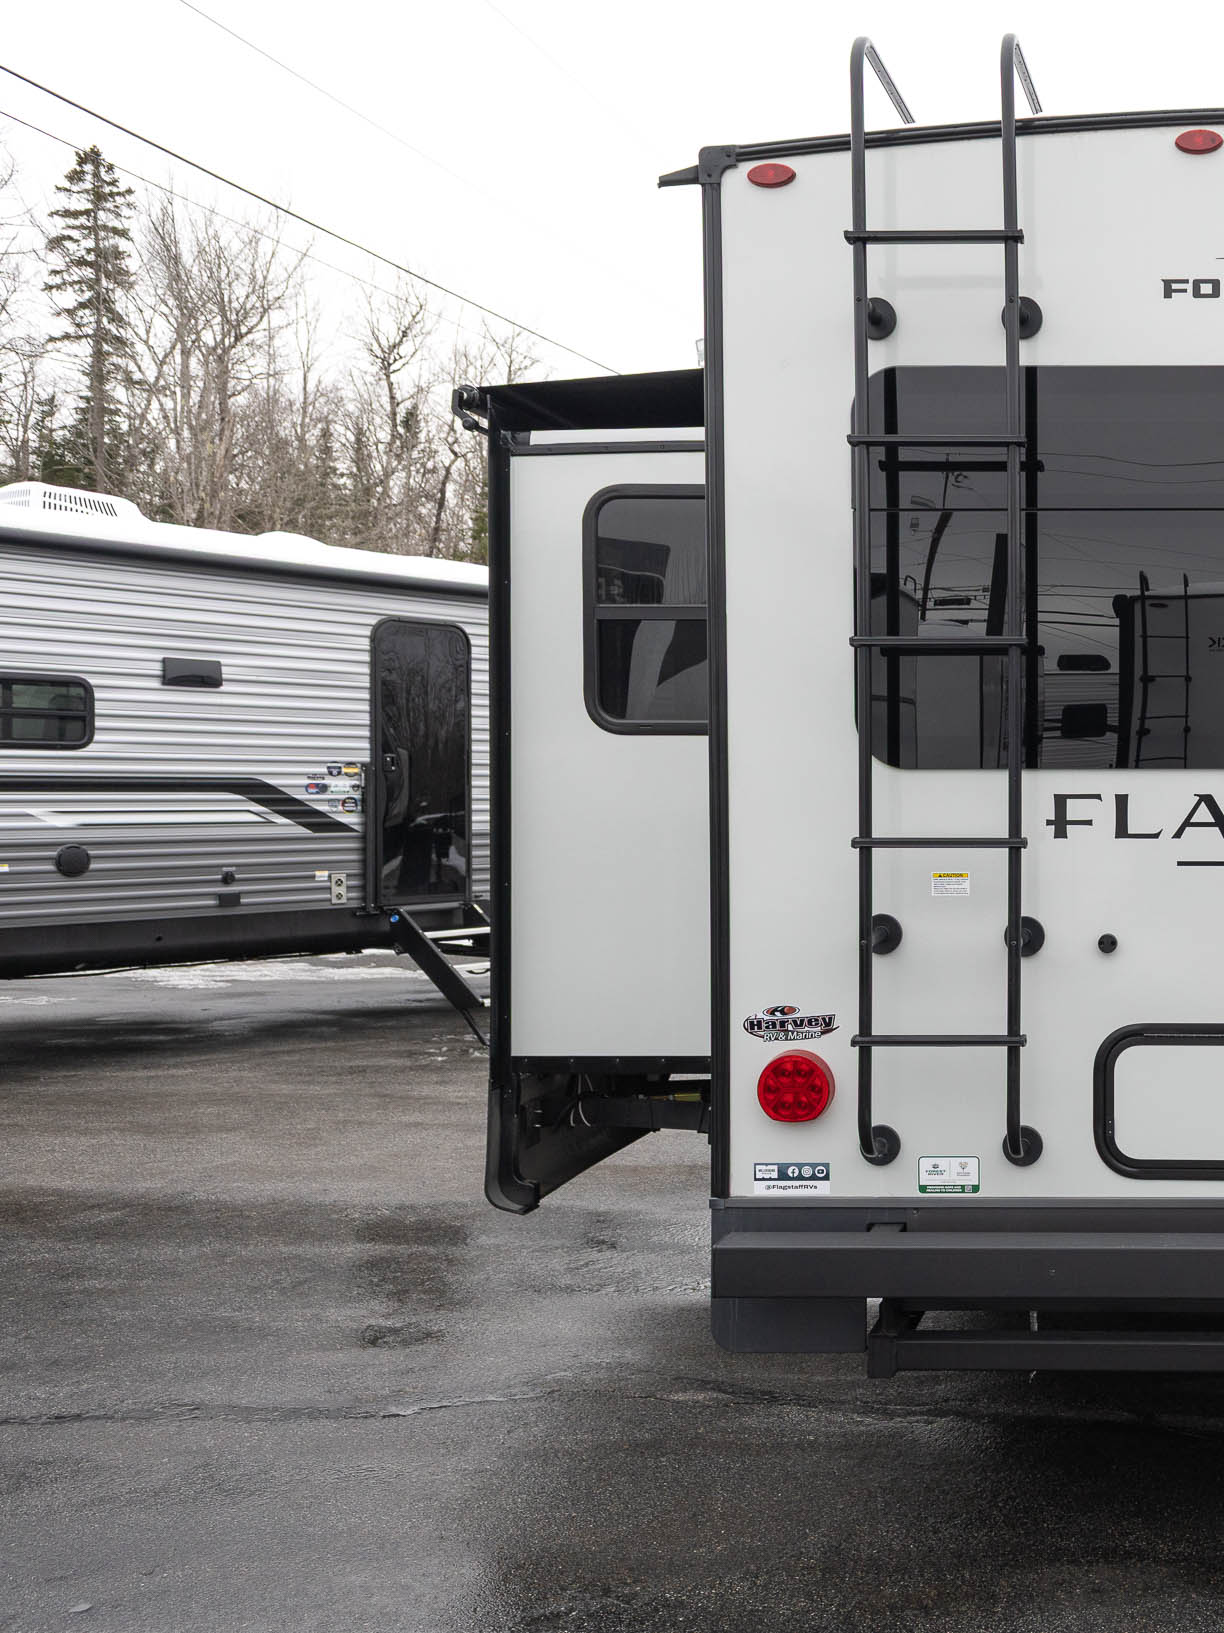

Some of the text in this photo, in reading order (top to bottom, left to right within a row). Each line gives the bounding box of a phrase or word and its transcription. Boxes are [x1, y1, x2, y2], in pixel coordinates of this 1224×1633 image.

[747, 1015, 835, 1032] Harvey
[764, 1030, 821, 1041] RV & Marine
